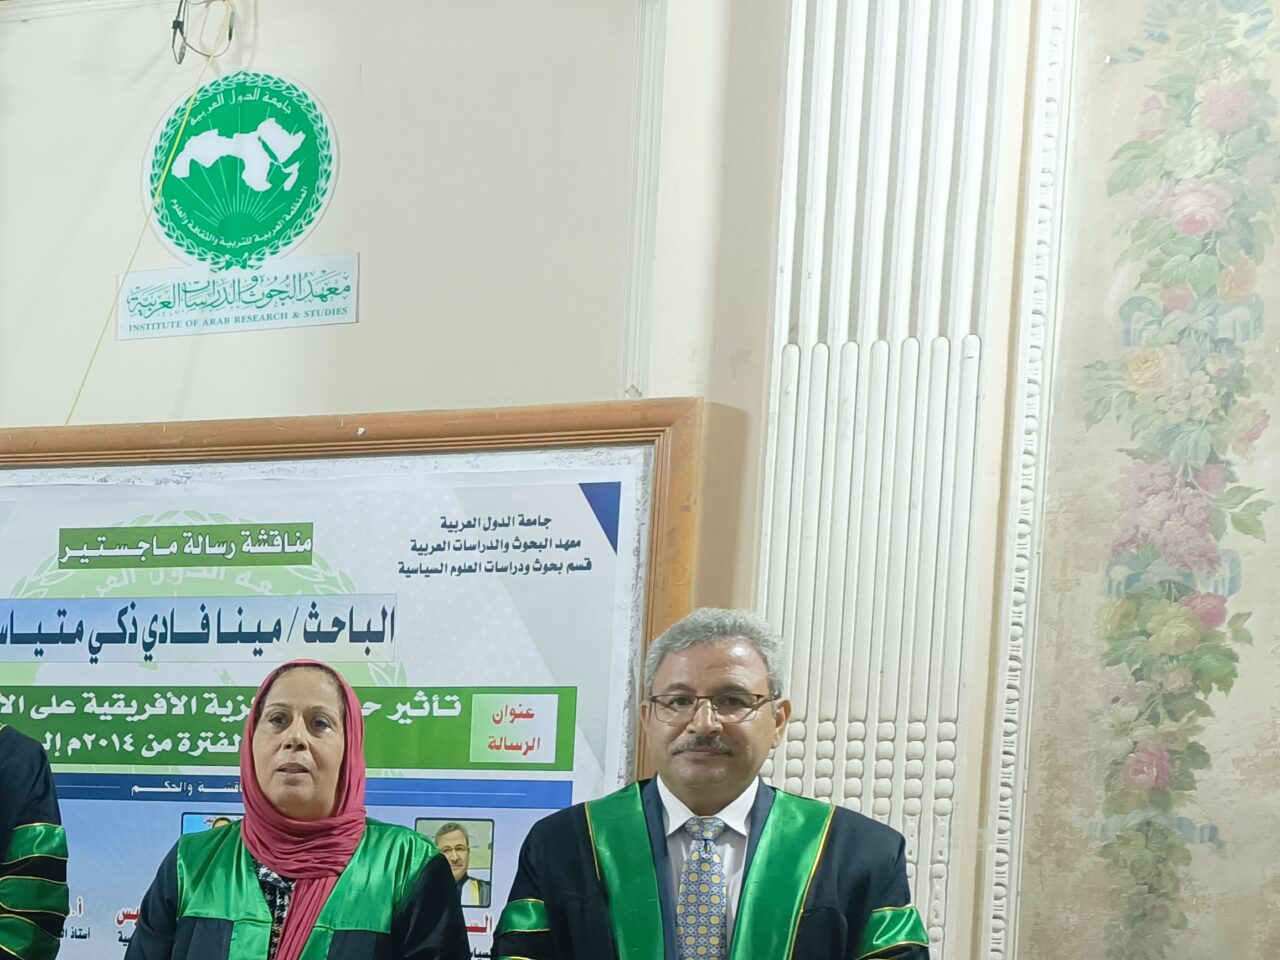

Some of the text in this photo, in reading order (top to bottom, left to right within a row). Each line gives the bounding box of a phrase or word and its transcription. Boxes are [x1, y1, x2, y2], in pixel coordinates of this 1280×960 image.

[188, 87, 292, 126] جامعة الدول العربية
[170, 186, 308, 249] المنظمة العربية للتربية والثقافة والعلوم
[305, 273, 352, 304] معهد
[128, 307, 348, 332] INSTITUTE OF ARAB RESEARCH & STUDIES
[440, 513, 552, 533] جامعة الدول العربية
[58, 529, 313, 564] مناقشة رسالة ماجستير
[410, 535, 582, 556] معهد البحوث والدراسات العربية
[398, 557, 593, 578] قسم بحوث ودراسات العلوم السياسية
[87, 601, 140, 664] ذكي
[141, 602, 210, 663] فادي
[216, 603, 282, 657] مينا
[302, 601, 396, 656] الباحث
[29, 694, 77, 719] على
[83, 691, 197, 722] الأفريقية
[385, 690, 462, 725] تأثير
[492, 703, 535, 724] عنوان
[141, 733, 173, 757] من
[487, 736, 541, 756] الرسالة
[131, 781, 193, 797] والحكم
